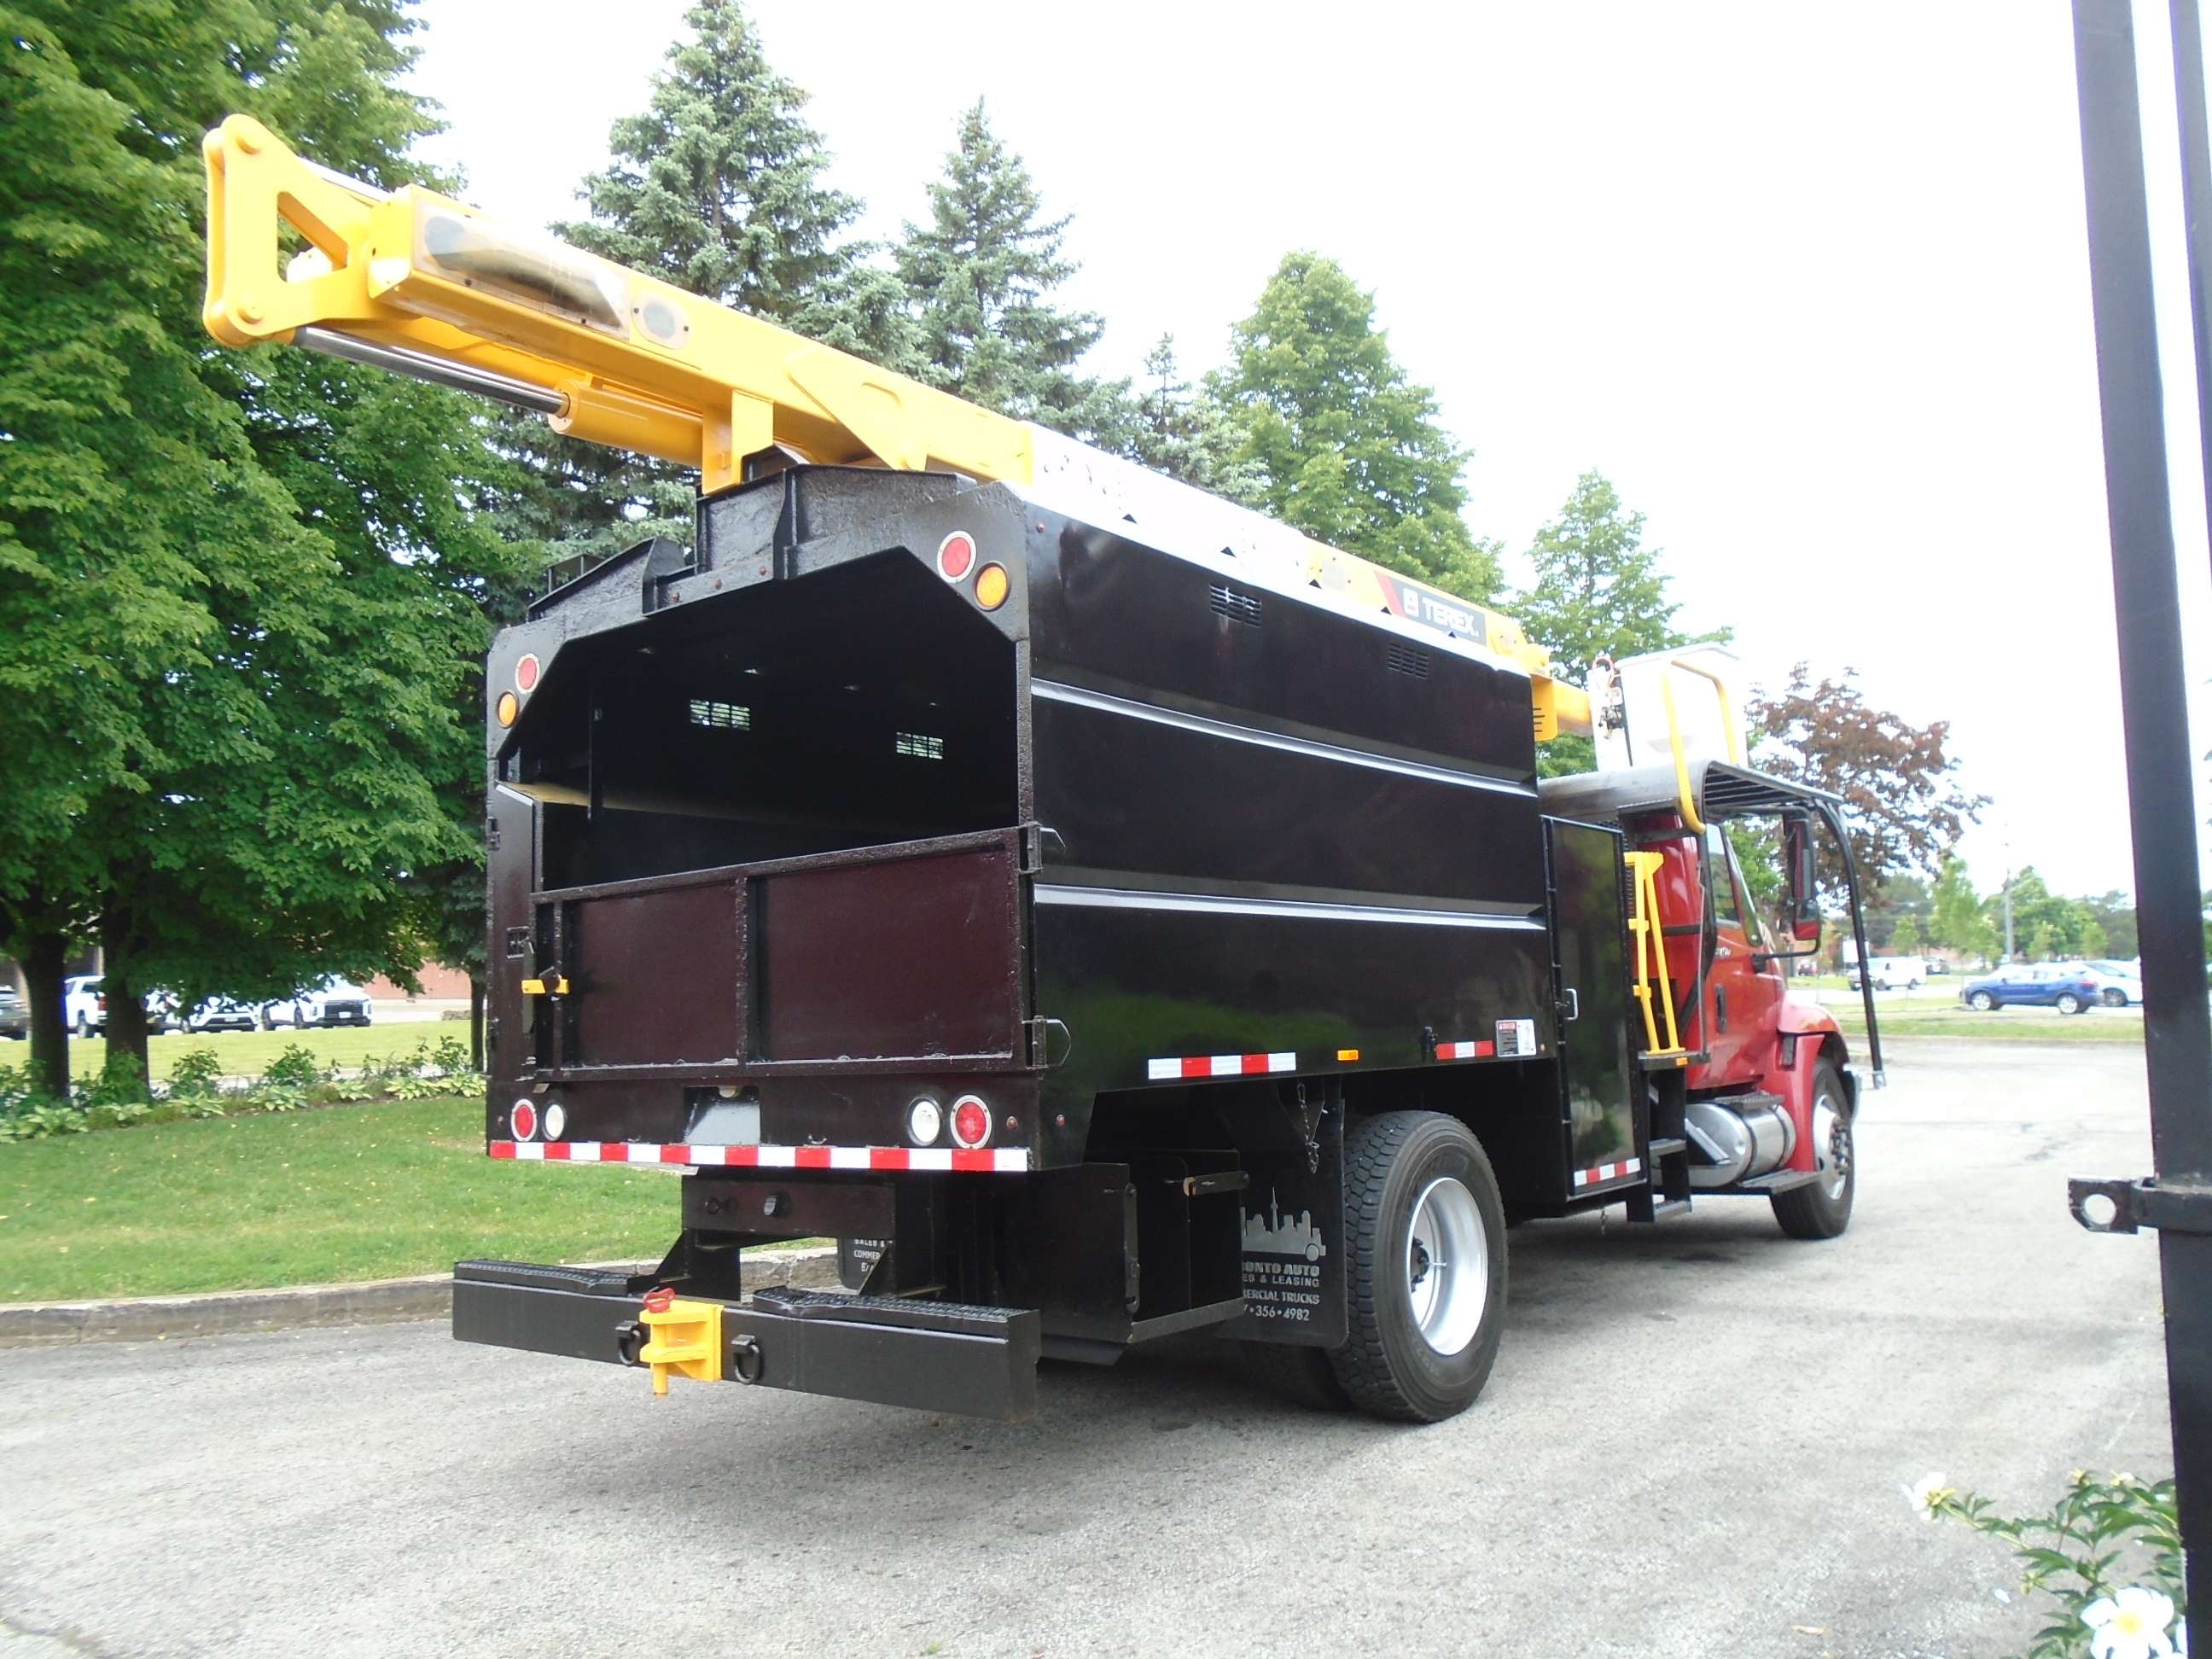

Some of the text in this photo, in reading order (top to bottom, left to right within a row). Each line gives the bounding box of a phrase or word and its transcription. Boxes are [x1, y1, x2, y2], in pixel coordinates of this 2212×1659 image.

[1422, 597, 1476, 636] TEREX
[1243, 1261, 1319, 1277] ONTO AUTO
[1272, 1275, 1319, 1288] LEASING
[1282, 1291, 1319, 1305] TRUCKS
